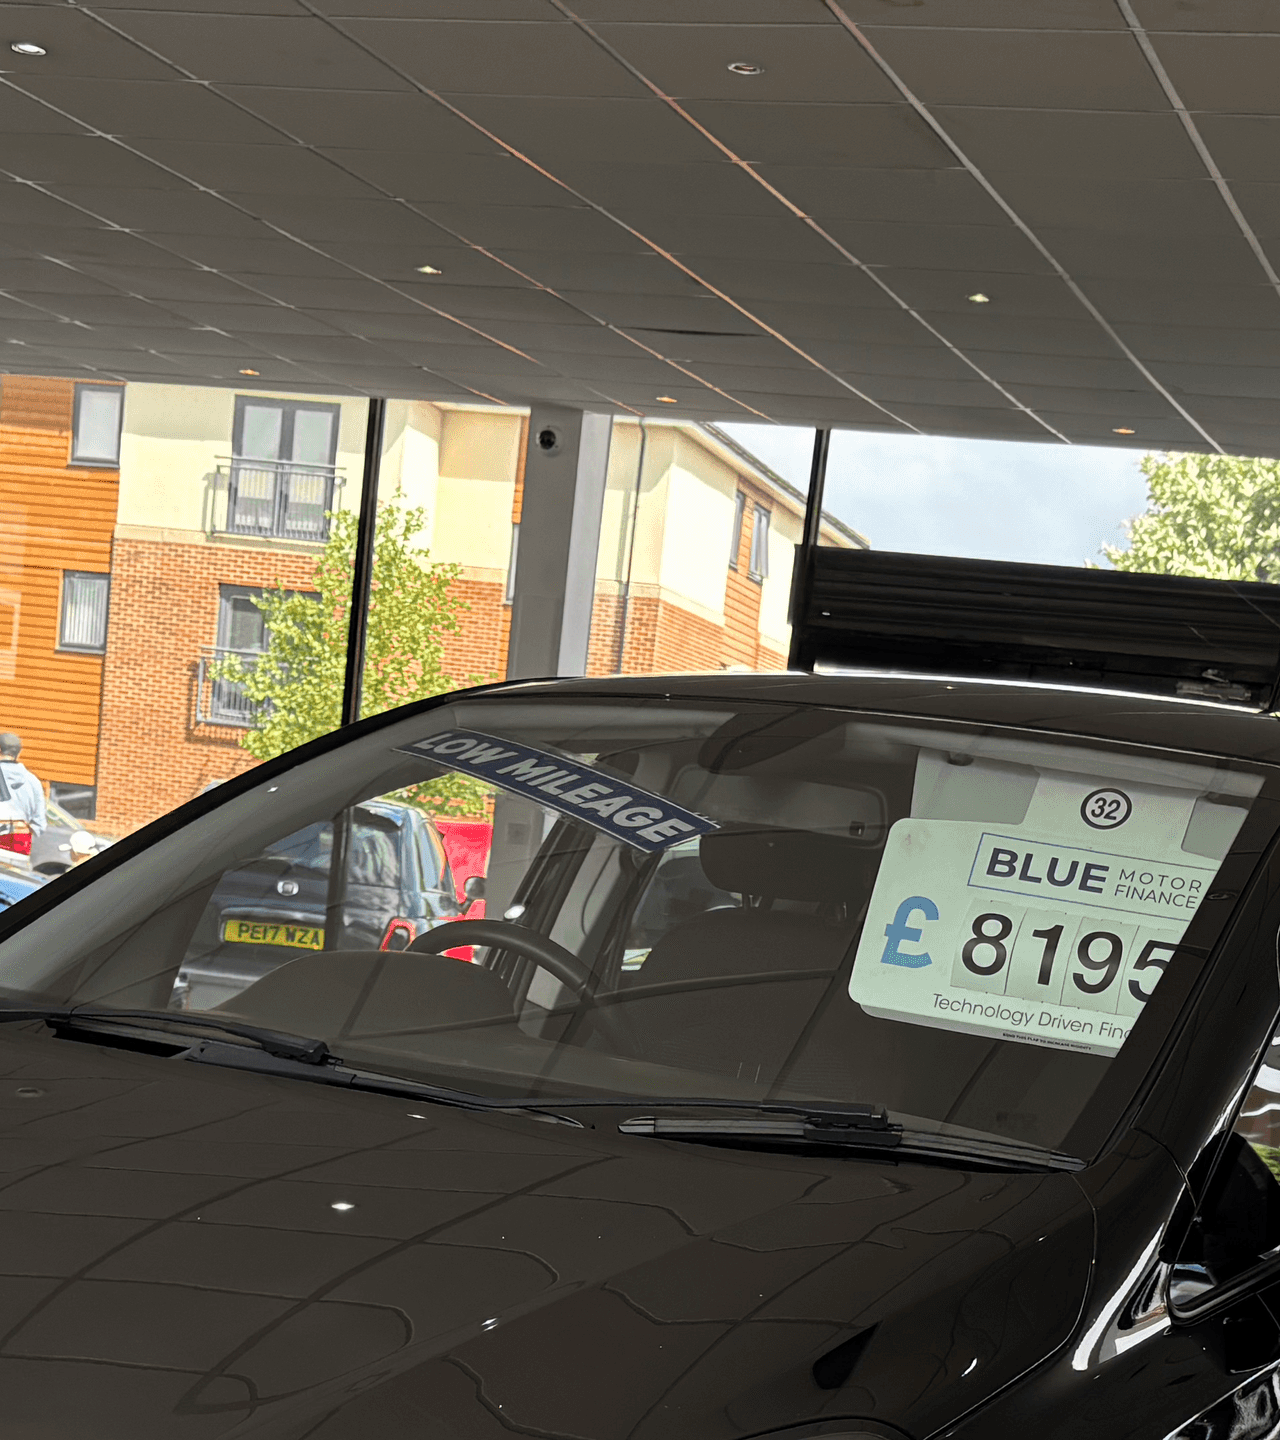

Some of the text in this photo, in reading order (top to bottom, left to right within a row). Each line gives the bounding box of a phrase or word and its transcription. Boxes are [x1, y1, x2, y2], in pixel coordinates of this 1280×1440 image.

[414, 733, 695, 843] LOW MILEAGE
[1091, 796, 1122, 821] 32
[986, 847, 1202, 894] BLUE MOTOR
[1115, 884, 1198, 909] FINANCE
[961, 913, 1180, 1003] 8195
[933, 993, 1035, 1026] Technology
[1038, 1011, 1094, 1034] Driven
